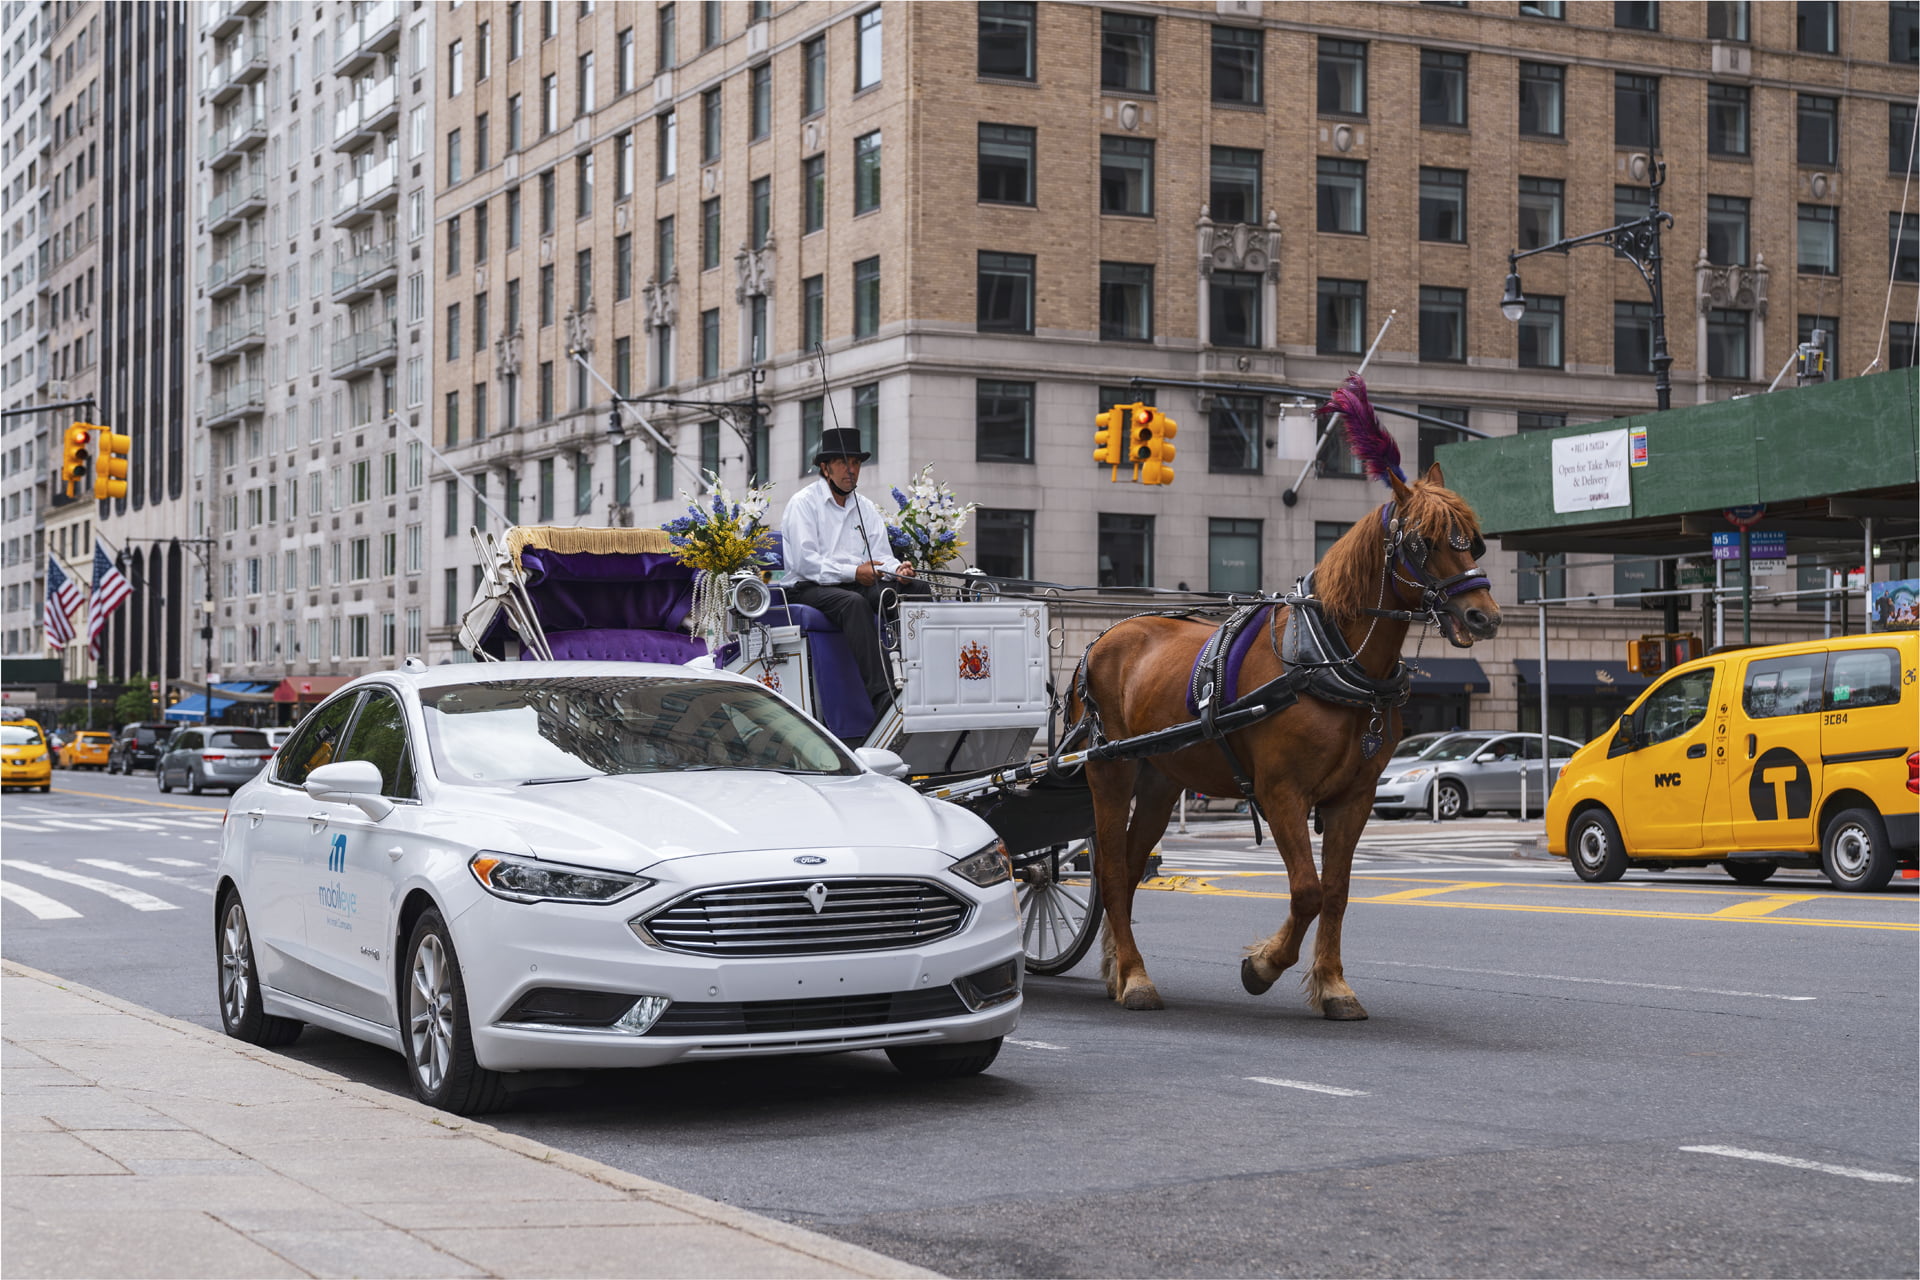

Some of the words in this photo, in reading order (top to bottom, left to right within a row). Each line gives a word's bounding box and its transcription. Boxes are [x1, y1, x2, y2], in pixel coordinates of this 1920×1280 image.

[1559, 464, 1575, 477] Open
[1577, 463, 1586, 472] for
[1588, 460, 1602, 471] Take
[1604, 459, 1621, 471] Away
[1573, 479, 1580, 487] &
[1582, 475, 1608, 487] Delivery
[1714, 534, 1729, 545] M5
[1715, 547, 1730, 558] M5
[1824, 713, 1848, 725] 3C84
[1654, 772, 1681, 788] NYC
[1763, 765, 1797, 820] T
[319, 880, 357, 918] mobileye
